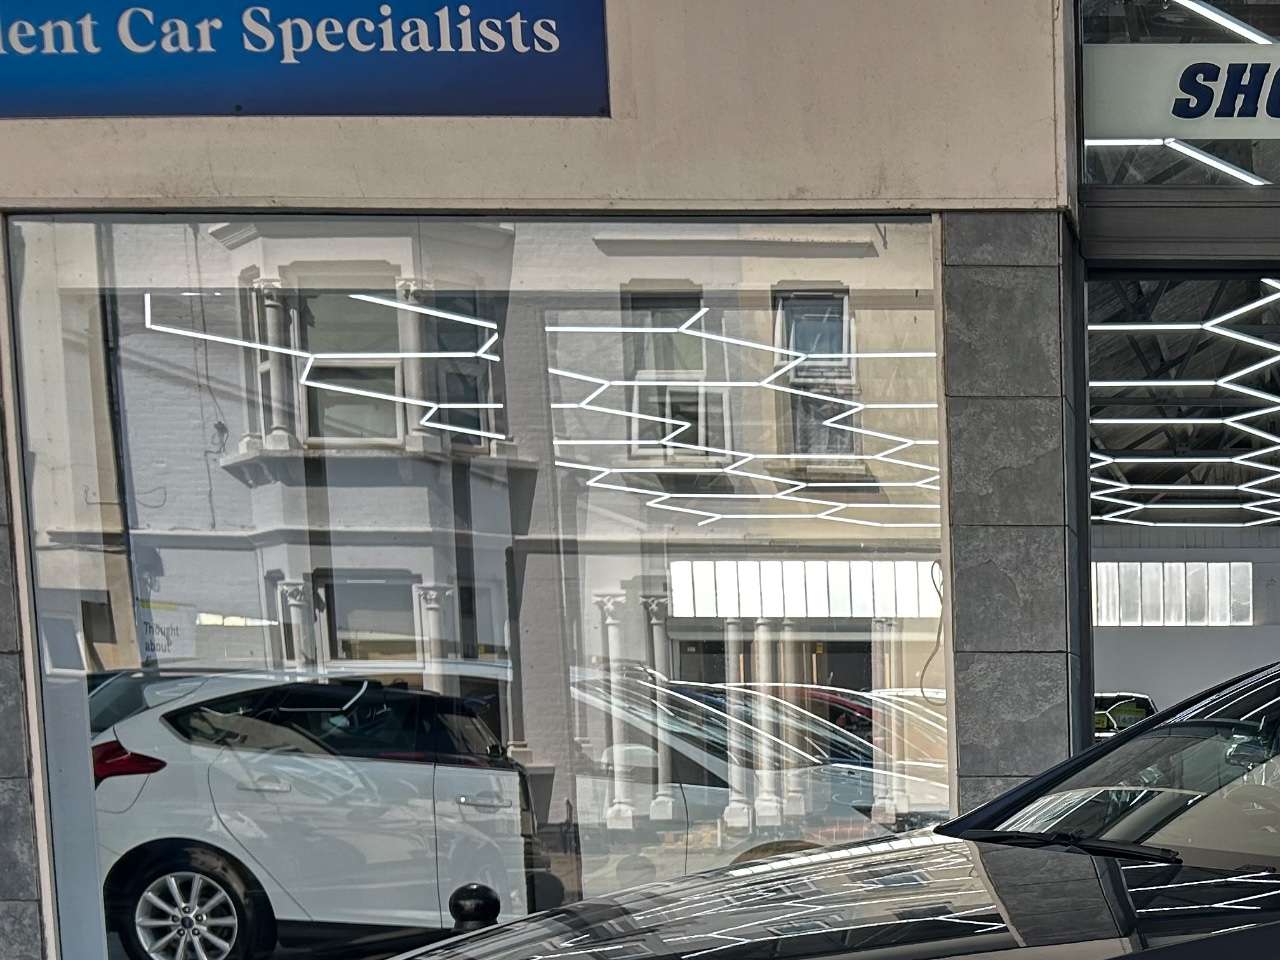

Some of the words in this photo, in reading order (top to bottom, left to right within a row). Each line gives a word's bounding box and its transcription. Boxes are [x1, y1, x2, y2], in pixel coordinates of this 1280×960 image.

[0, 12, 101, 54] ent
[117, 7, 223, 53] Car
[242, 4, 560, 64] Specialists
